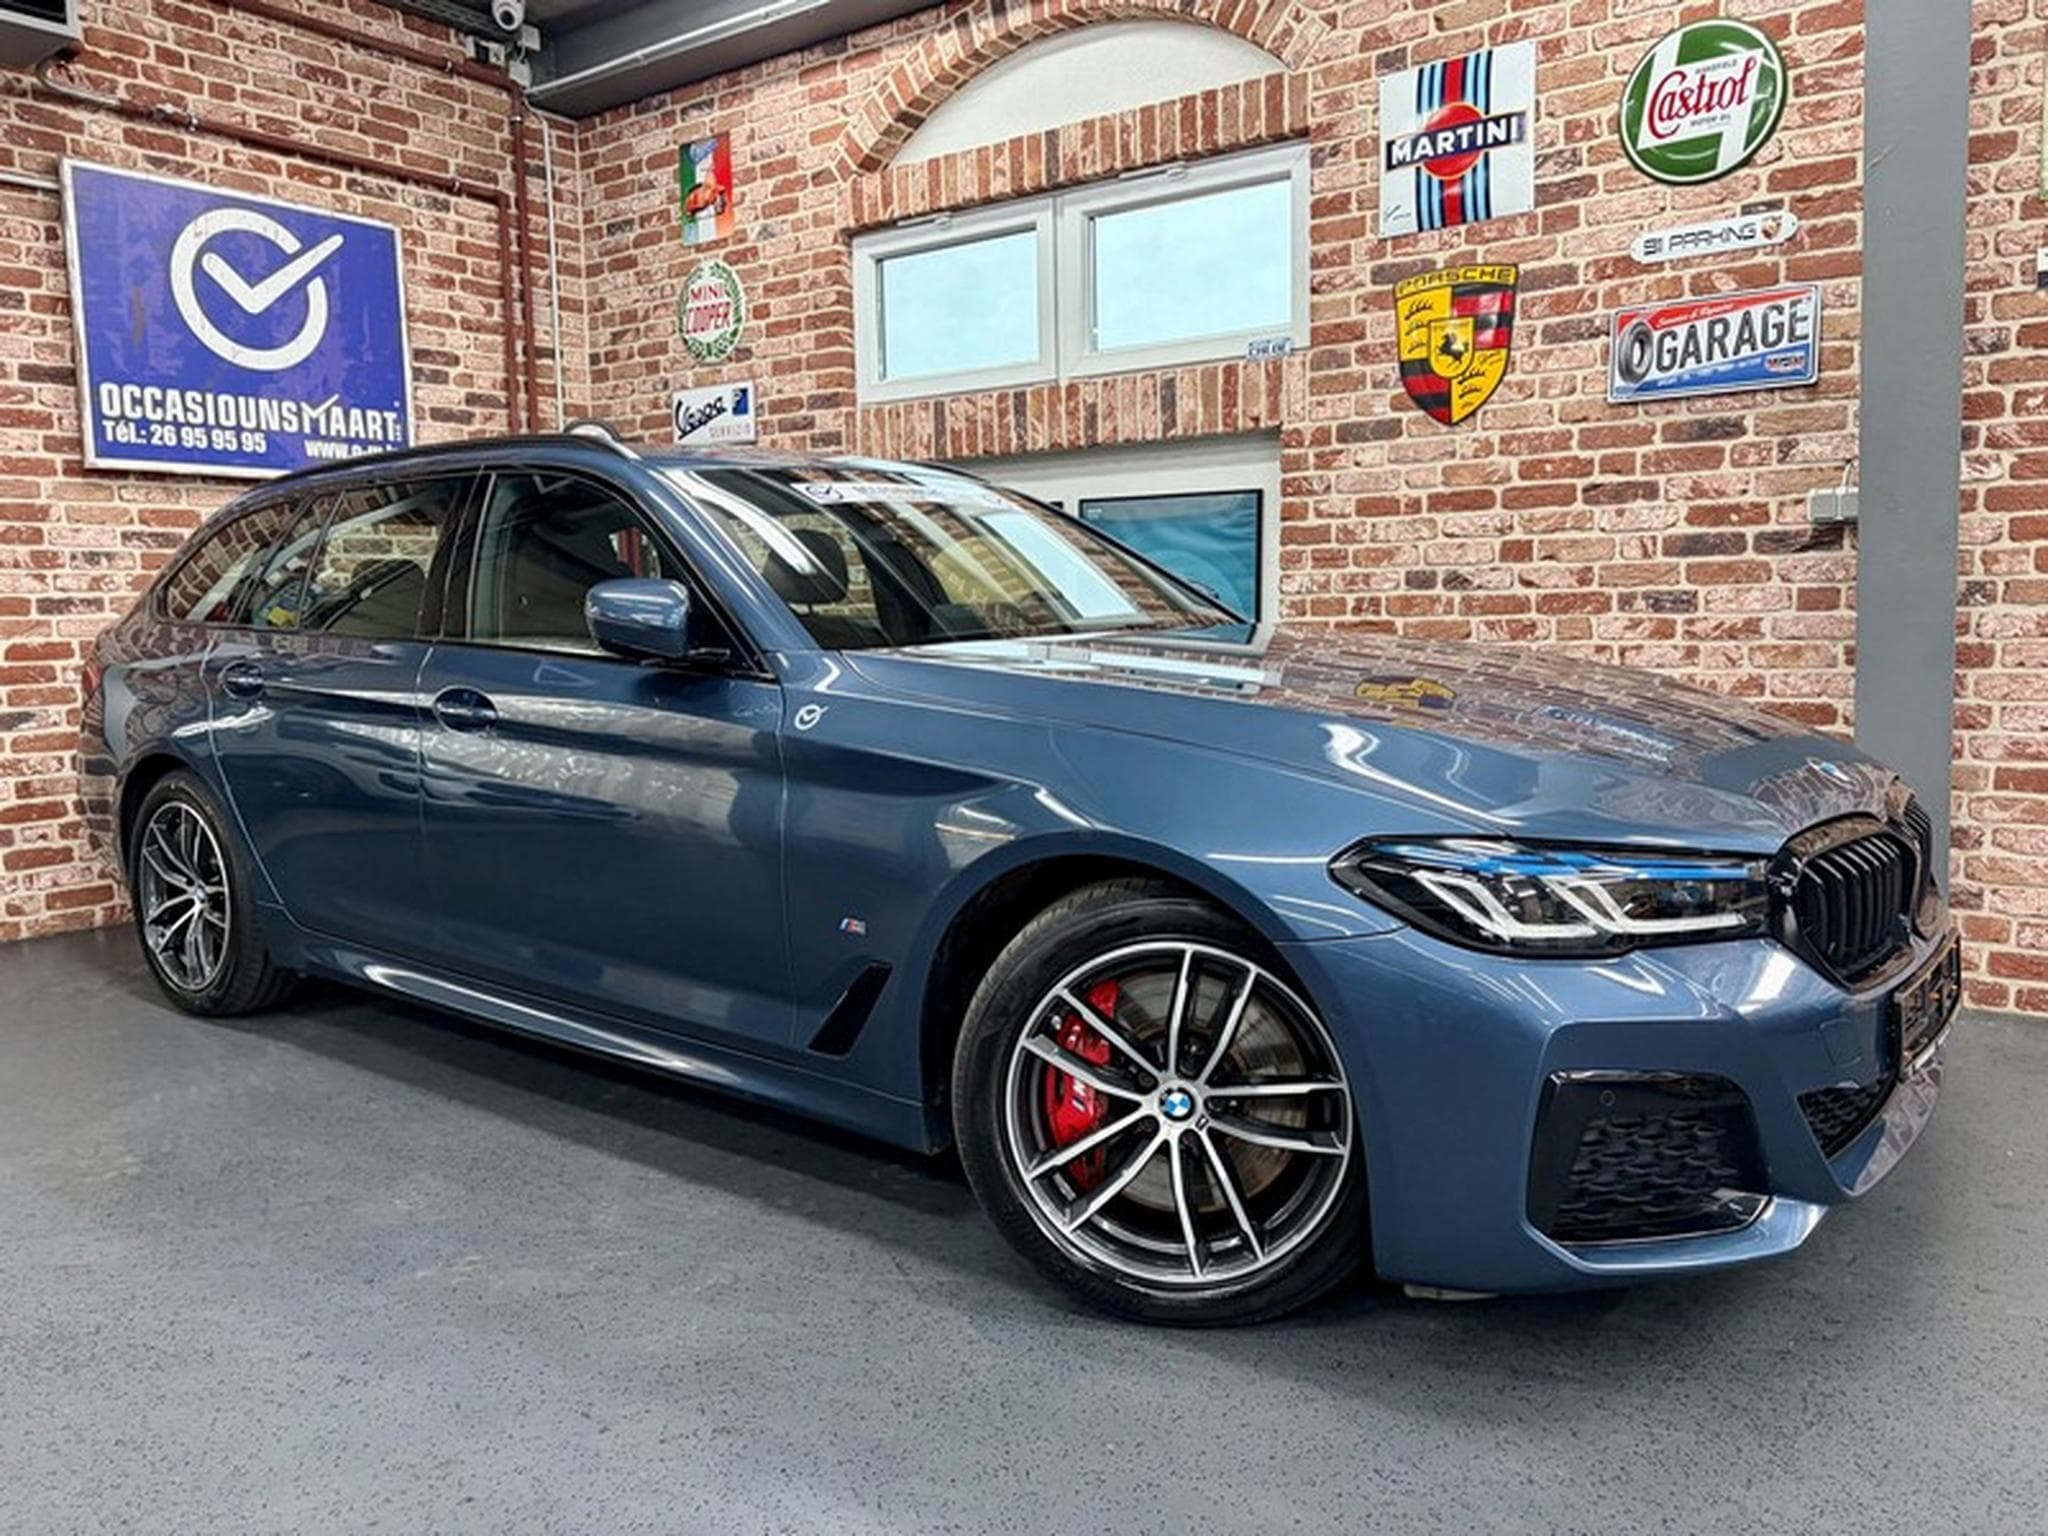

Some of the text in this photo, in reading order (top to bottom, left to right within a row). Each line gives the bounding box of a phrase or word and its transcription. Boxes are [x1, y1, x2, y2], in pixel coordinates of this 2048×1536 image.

[1647, 56, 1757, 140] Castrol
[1391, 116, 1519, 165] MARTINI
[1669, 222, 1757, 251] PARKING
[690, 283, 732, 301] MINI
[1401, 267, 1512, 294] PORSCHE
[686, 301, 731, 334] COOPER
[1656, 298, 1810, 374] GARAGE
[675, 398, 727, 440] Vespa
[151, 426, 176, 448] 26
[181, 428, 210, 449] 95
[212, 431, 238, 451] 95
[241, 432, 267, 454] 95
